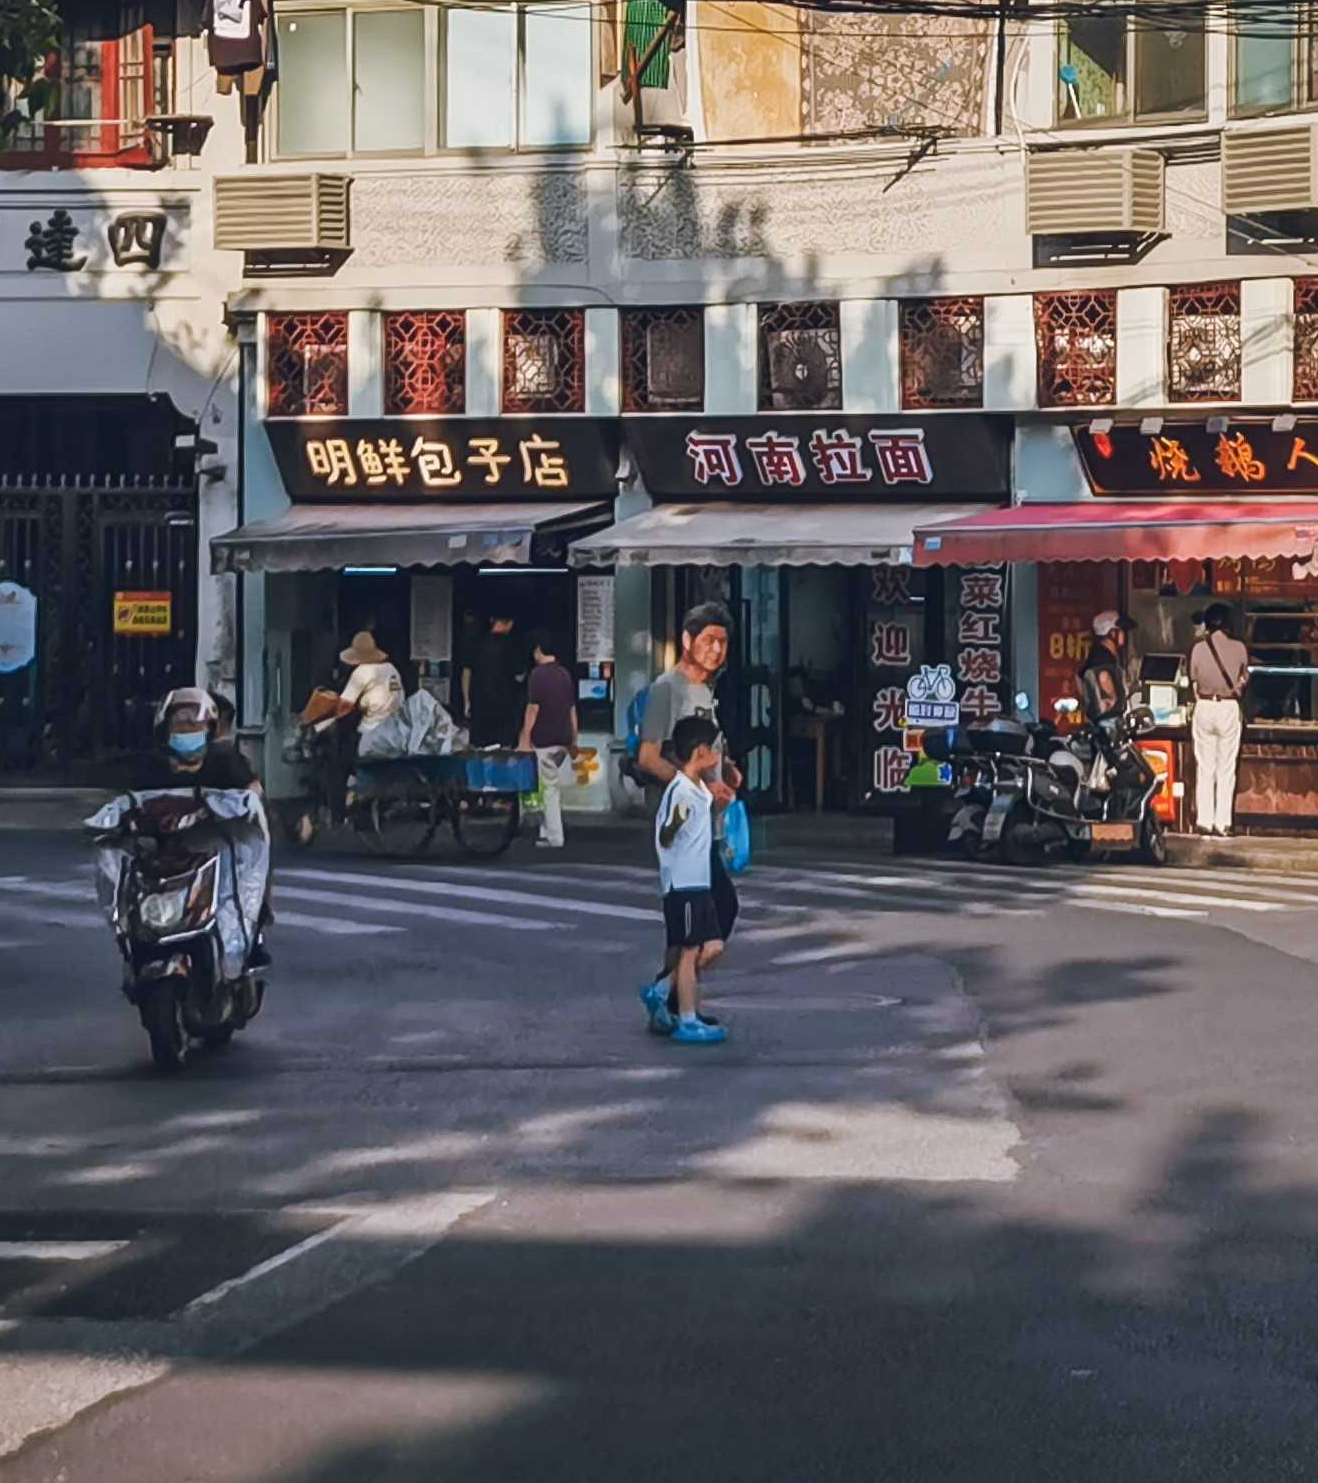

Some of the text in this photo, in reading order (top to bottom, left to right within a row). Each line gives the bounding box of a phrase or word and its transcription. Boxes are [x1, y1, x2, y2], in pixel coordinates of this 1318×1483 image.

[306, 433, 569, 488] 明鲜包子店
[686, 428, 934, 486] 河南拉面
[957, 561, 1003, 728] 菜红烧牛
